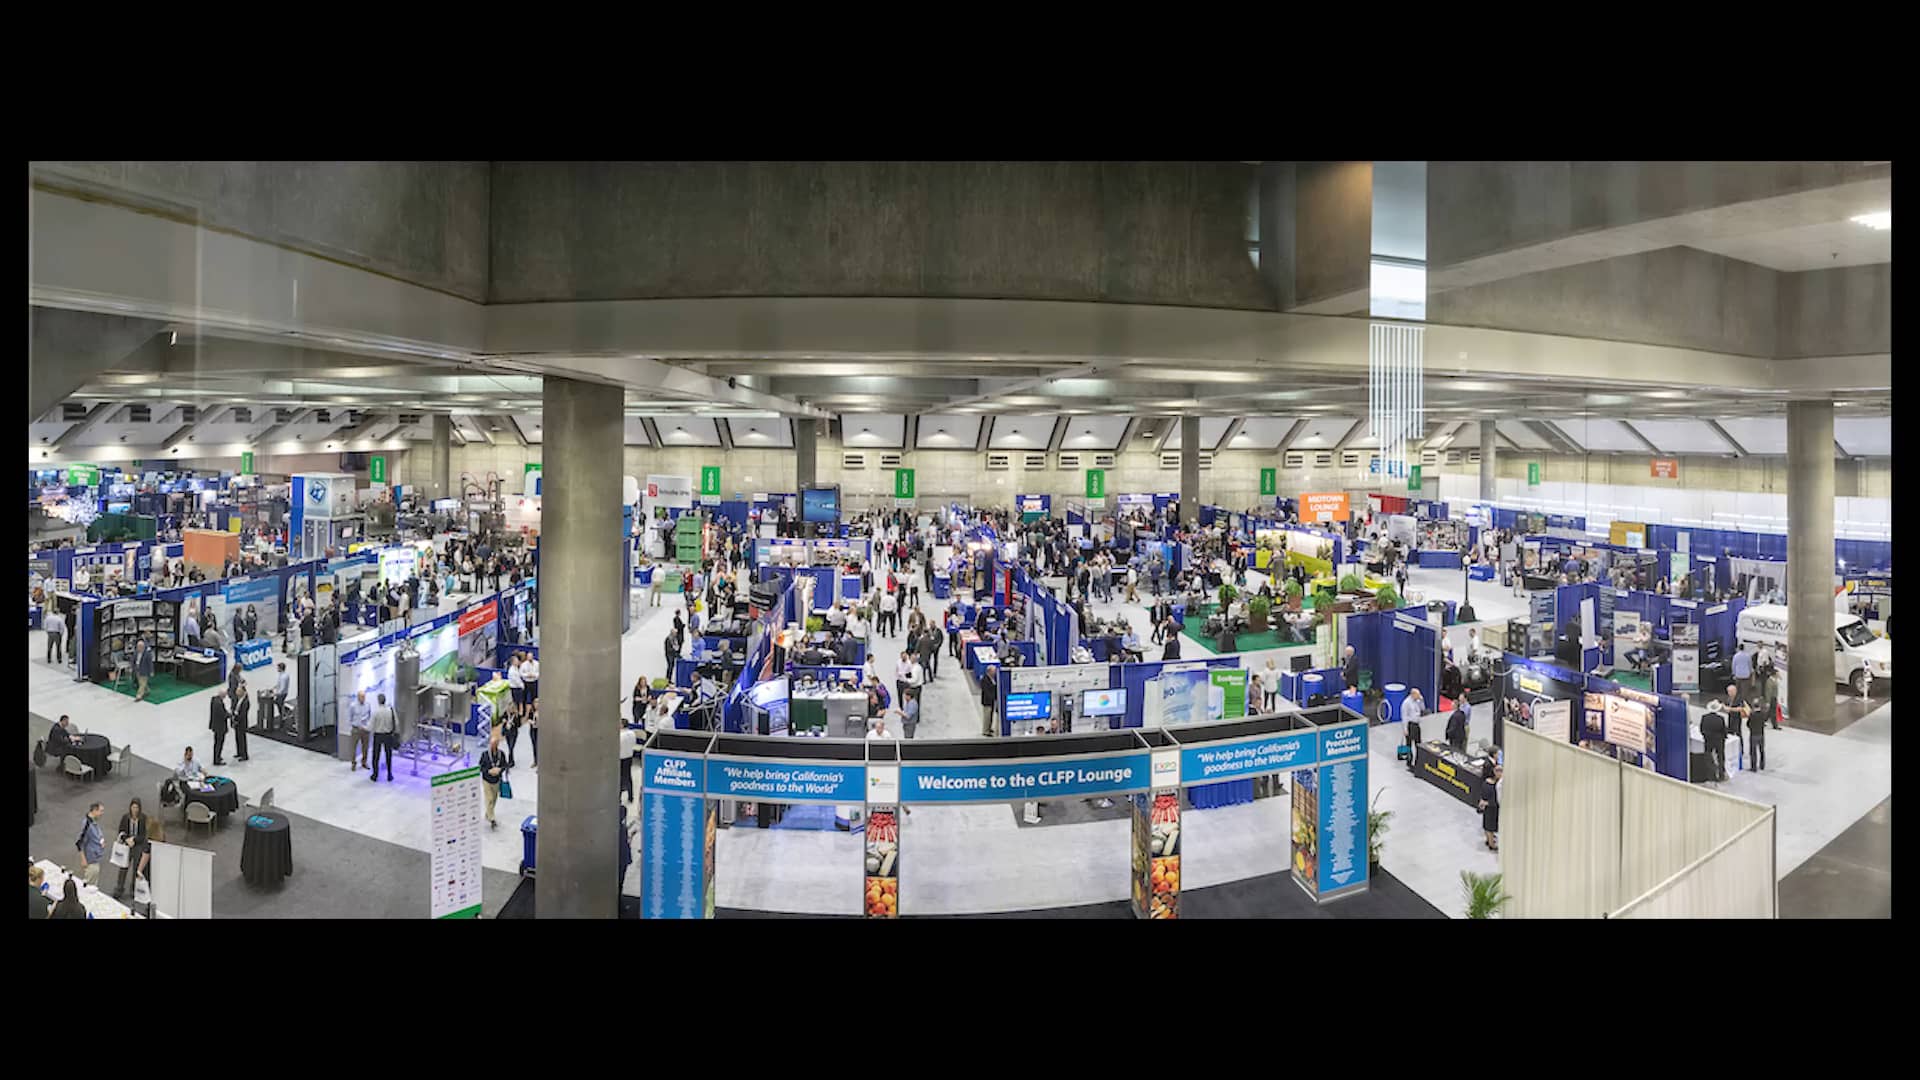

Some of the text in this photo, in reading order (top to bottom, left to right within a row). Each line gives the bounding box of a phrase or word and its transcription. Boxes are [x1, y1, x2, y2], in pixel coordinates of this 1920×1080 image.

[1308, 495, 1345, 503] MIDTOWN
[1310, 503, 1340, 512] LOUNGE
[1334, 729, 1354, 739] CLFP
[1326, 736, 1361, 749] Processor
[1215, 750, 1234, 761] help
[1234, 747, 1257, 759] bring
[1257, 741, 1300, 755] California's
[1327, 744, 1361, 756] Members
[663, 759, 687, 769] CLFP
[1204, 761, 1243, 776] goodness
[1244, 759, 1253, 768] to
[1254, 757, 1268, 766] the
[656, 767, 693, 779] Affiliate
[743, 767, 764, 780] help
[765, 769, 790, 782] bring
[791, 770, 844, 783] California's
[918, 767, 1132, 789] Welcome to the CLFP Lounge
[653, 775, 697, 788] Members
[730, 780, 774, 792] goodness
[776, 782, 787, 792] to
[788, 783, 804, 793] the
